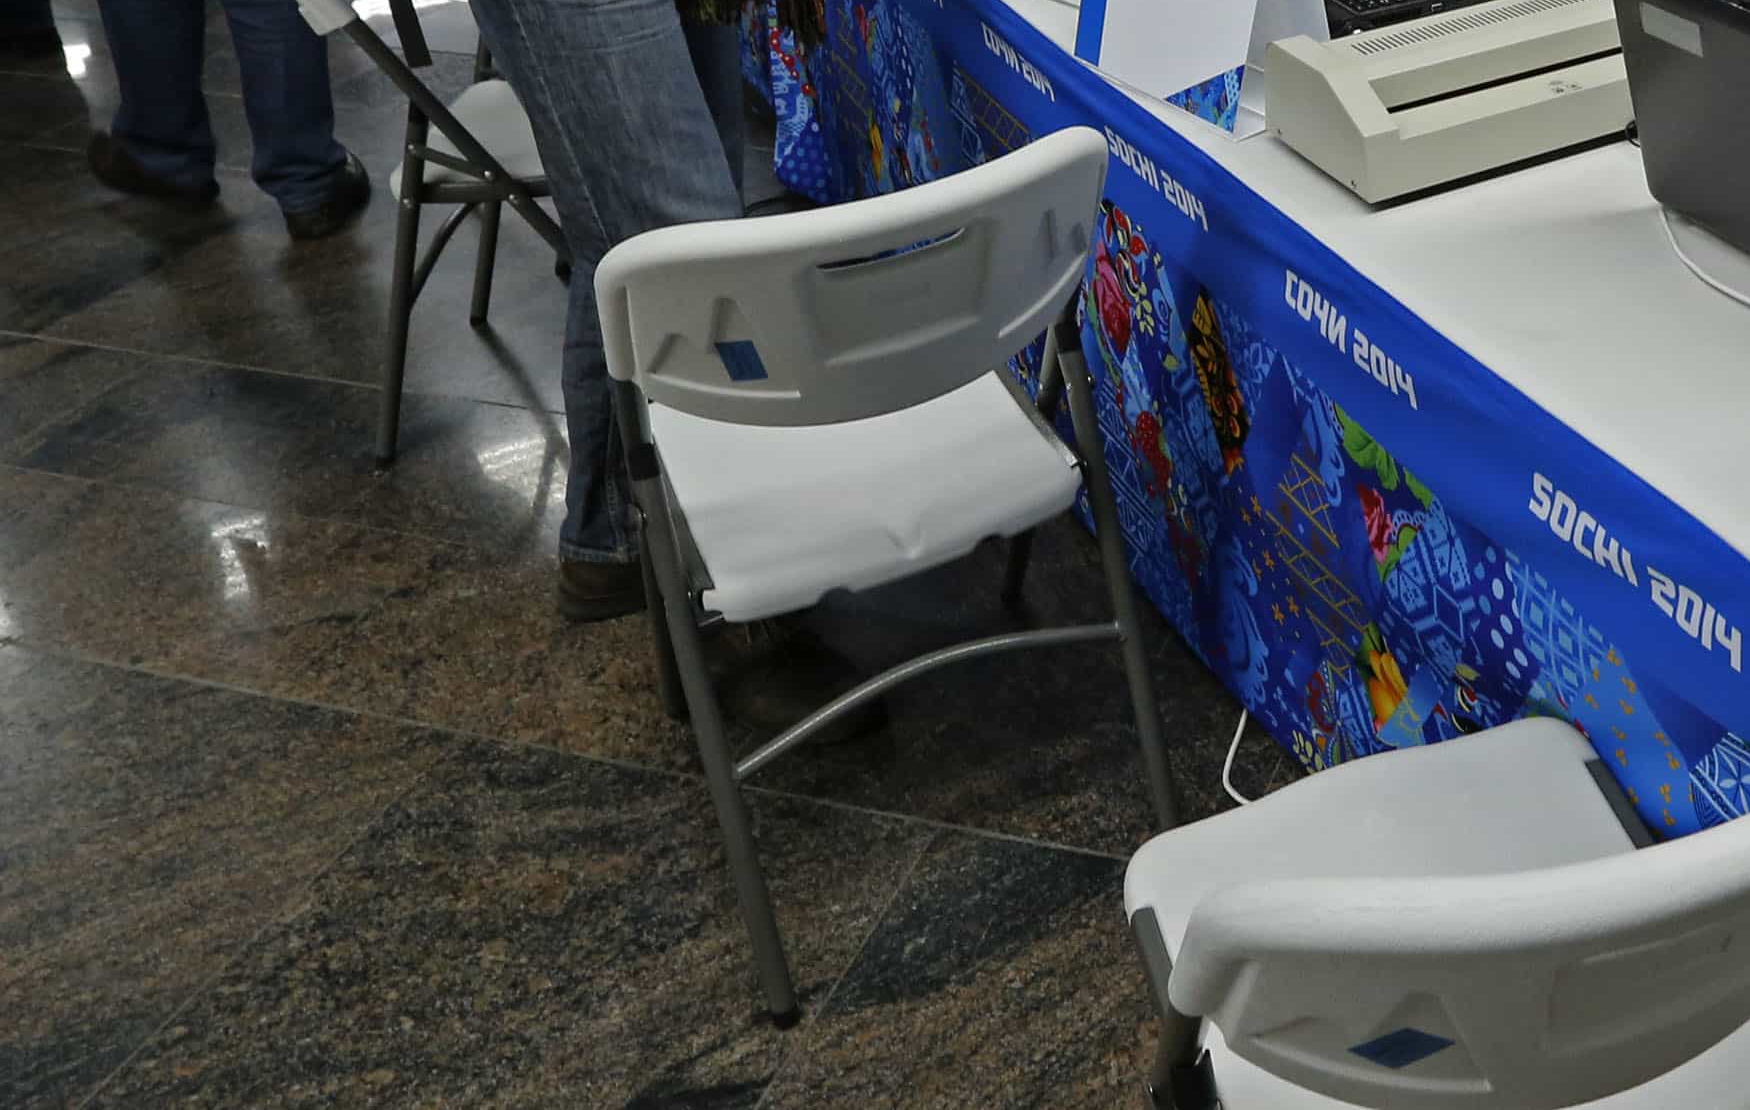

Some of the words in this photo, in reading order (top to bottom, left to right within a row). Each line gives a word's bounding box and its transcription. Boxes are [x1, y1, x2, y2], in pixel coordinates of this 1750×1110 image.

[1021, 60, 1056, 103] 2014
[1104, 125, 1160, 193] SOCHI
[1160, 169, 1209, 232] 2014
[1353, 327, 1418, 410] 2014
[1529, 472, 1638, 587] SOCHI
[1647, 566, 1742, 673] 2014
